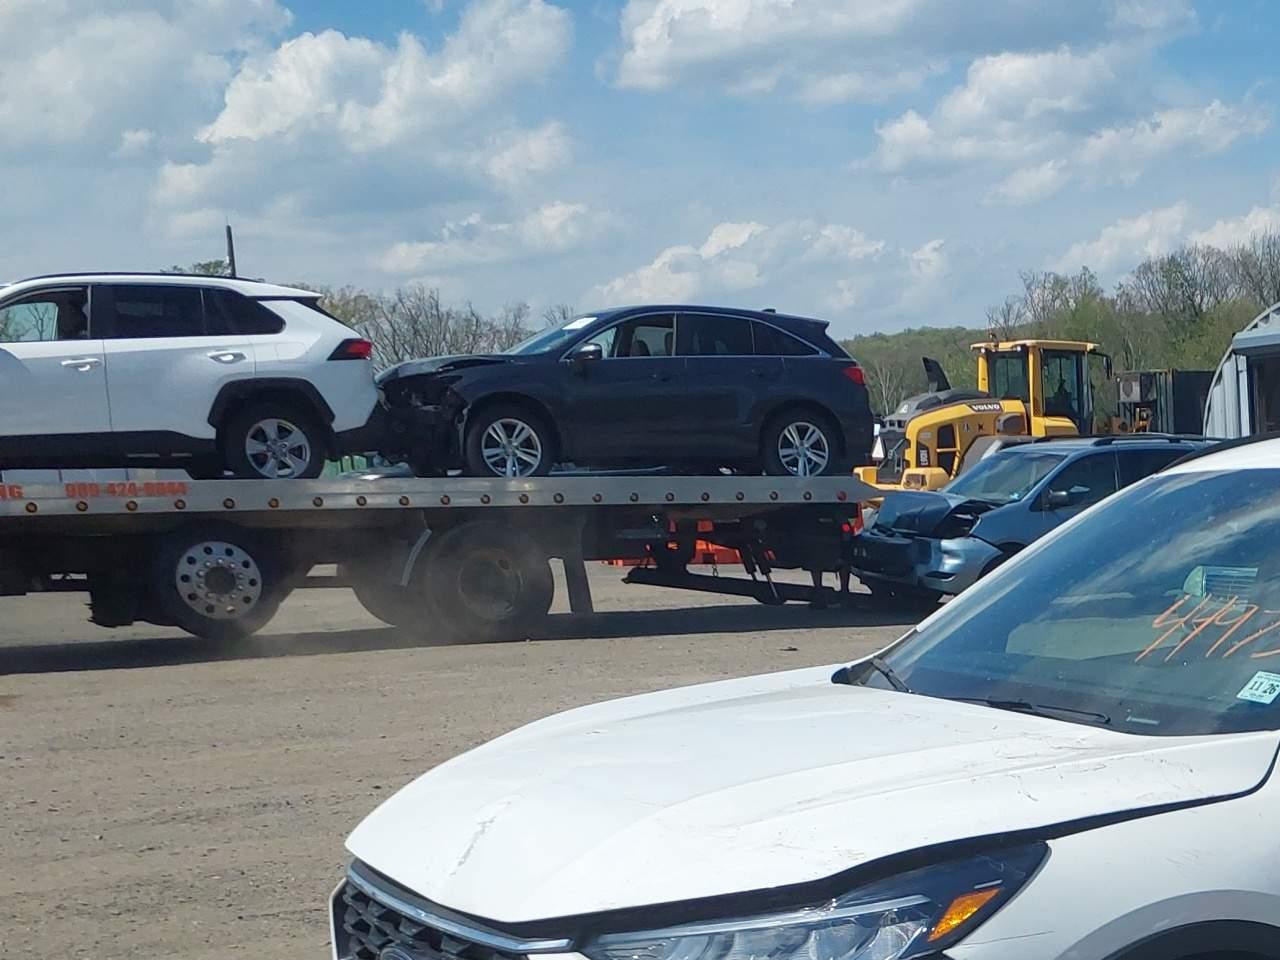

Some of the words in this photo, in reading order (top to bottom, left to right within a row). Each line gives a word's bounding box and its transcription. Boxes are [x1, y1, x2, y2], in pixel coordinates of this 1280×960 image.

[971, 403, 1000, 411] VOLVO
[1248, 680, 1265, 691] 11
[1262, 683, 1280, 695] 26
